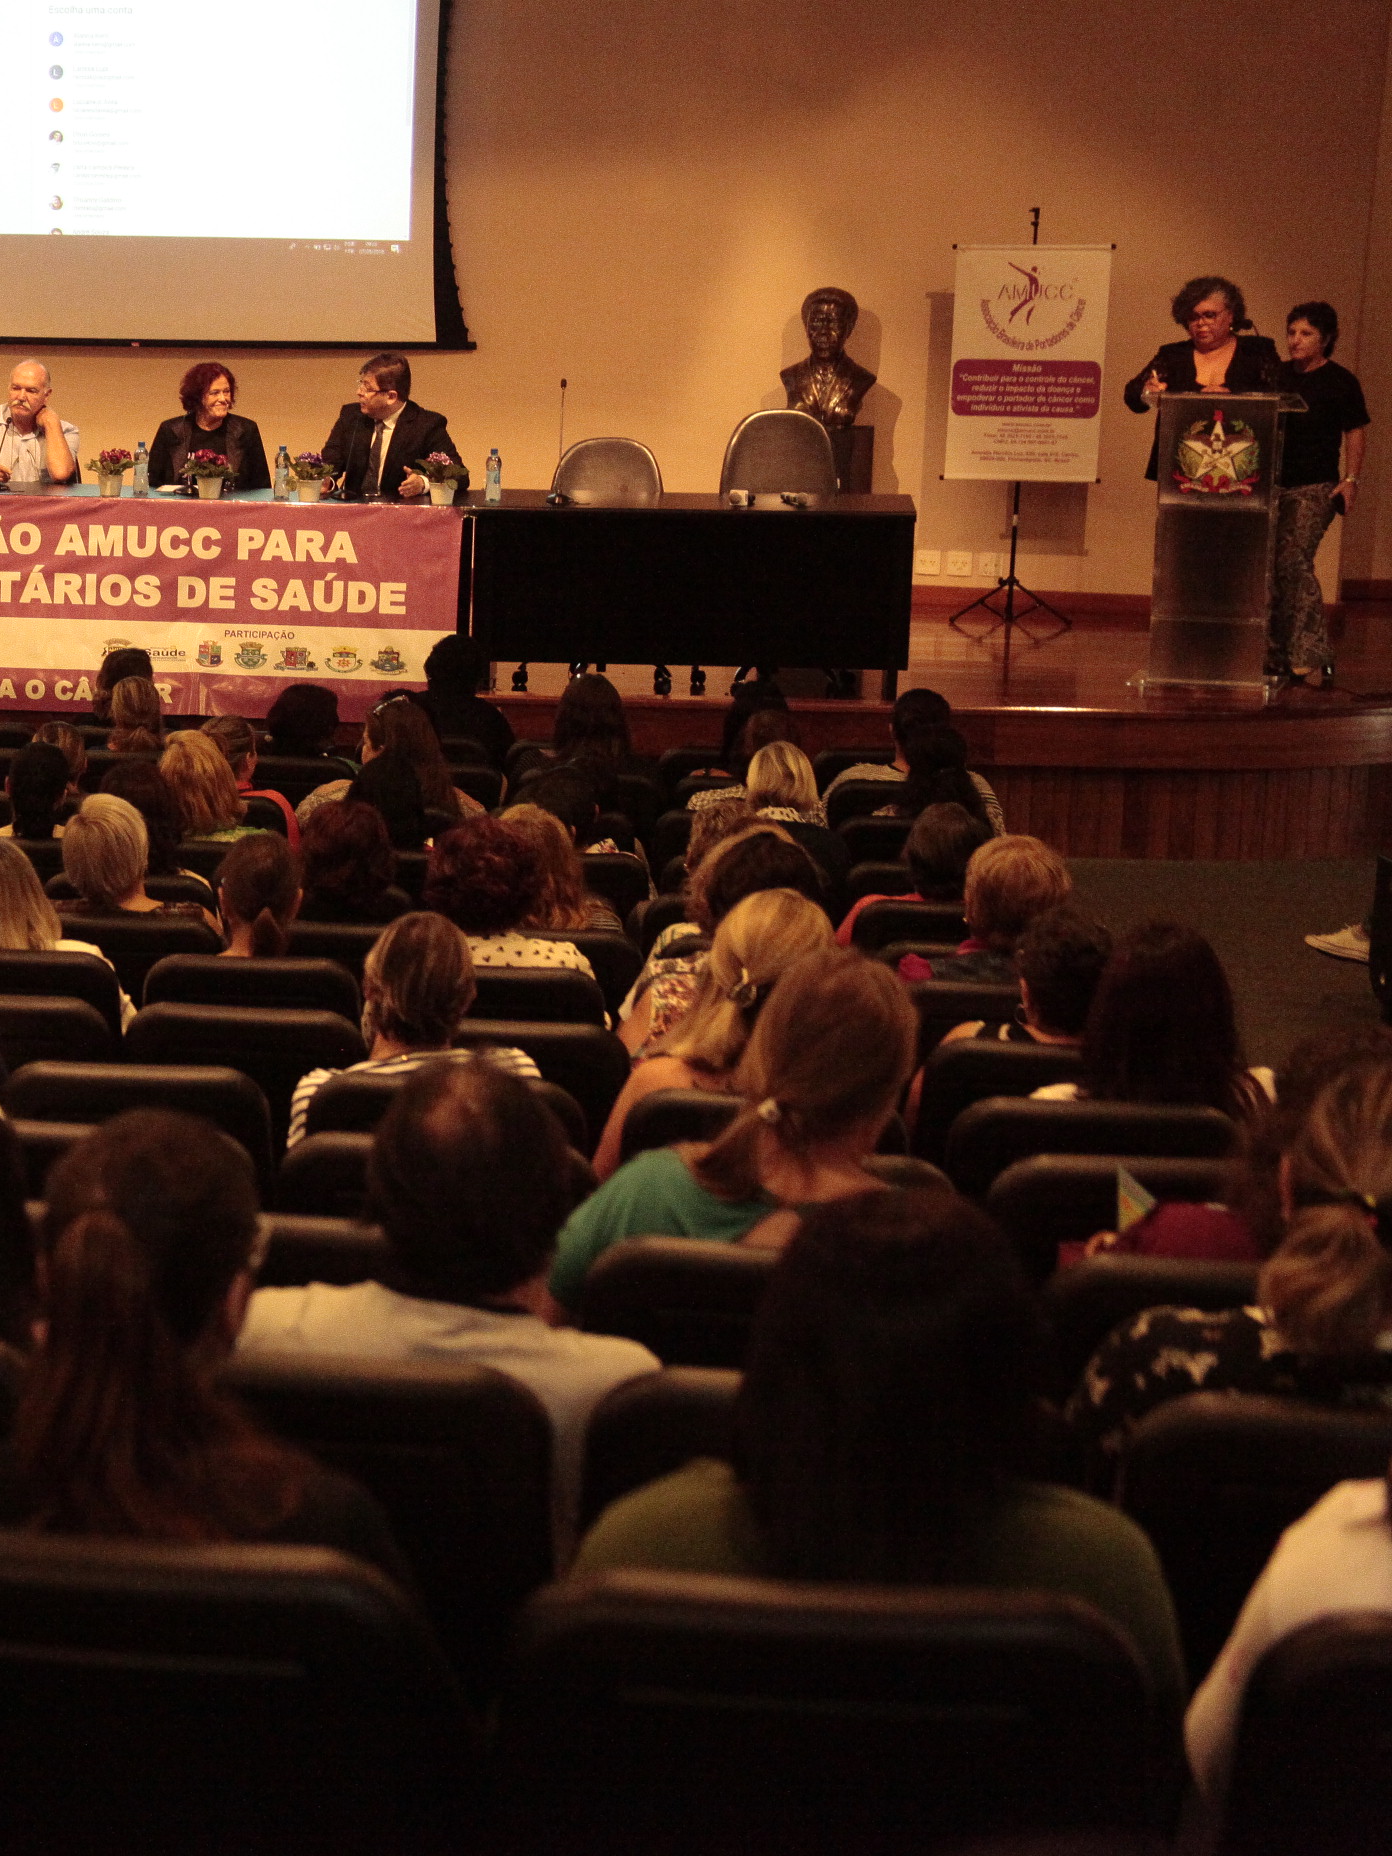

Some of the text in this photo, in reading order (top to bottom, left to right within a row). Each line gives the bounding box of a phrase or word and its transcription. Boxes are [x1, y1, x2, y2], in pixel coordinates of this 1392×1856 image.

[108, 6, 134, 14] conta
[1012, 364, 1042, 373] Missão
[55, 524, 221, 559] AMUCC
[238, 529, 357, 563] PARA
[178, 576, 236, 609] DE
[250, 573, 406, 614] SAÚDE
[224, 629, 295, 640] PARTICIPAÇÃO
[25, 680, 46, 700] O
[54, 676, 173, 704] CÂR
